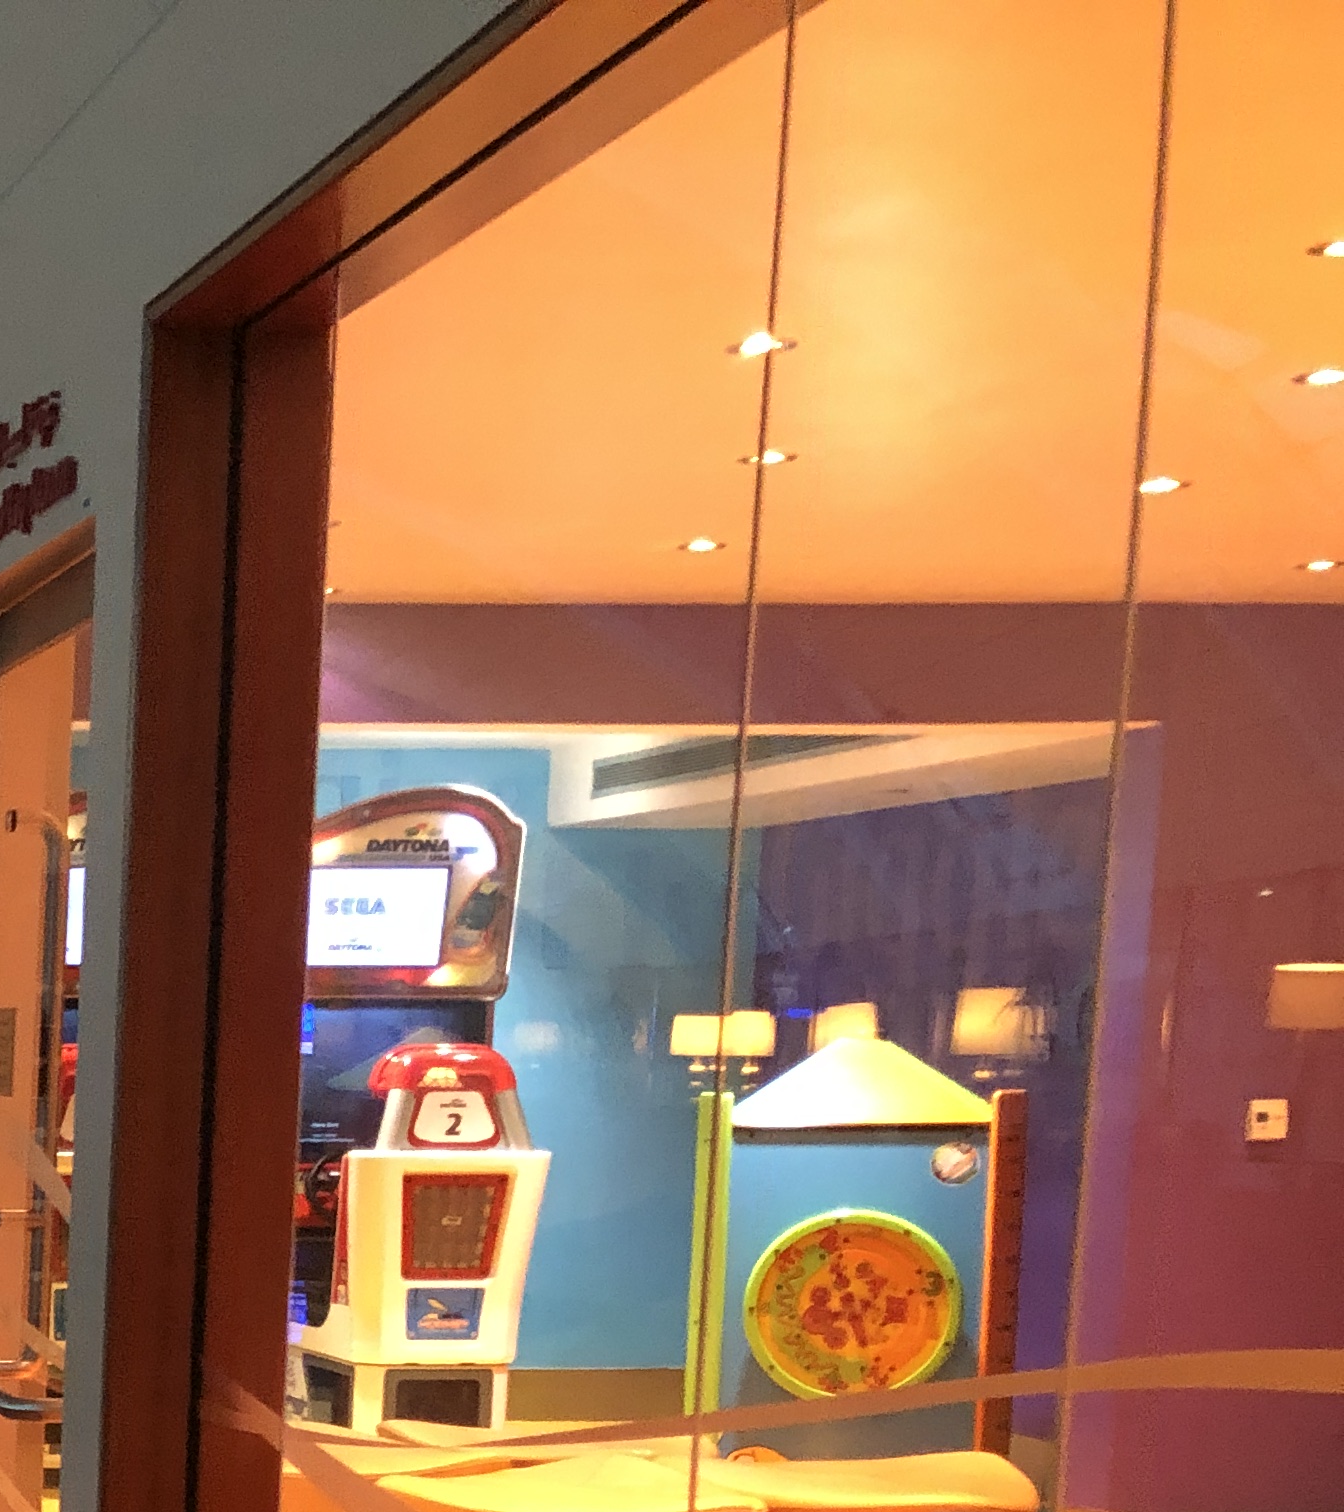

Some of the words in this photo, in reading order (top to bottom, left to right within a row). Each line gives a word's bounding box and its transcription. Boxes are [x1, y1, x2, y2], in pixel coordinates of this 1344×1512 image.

[366, 838, 449, 852] DAYTONA
[324, 898, 386, 916] SEGA
[444, 1113, 462, 1136] 2
